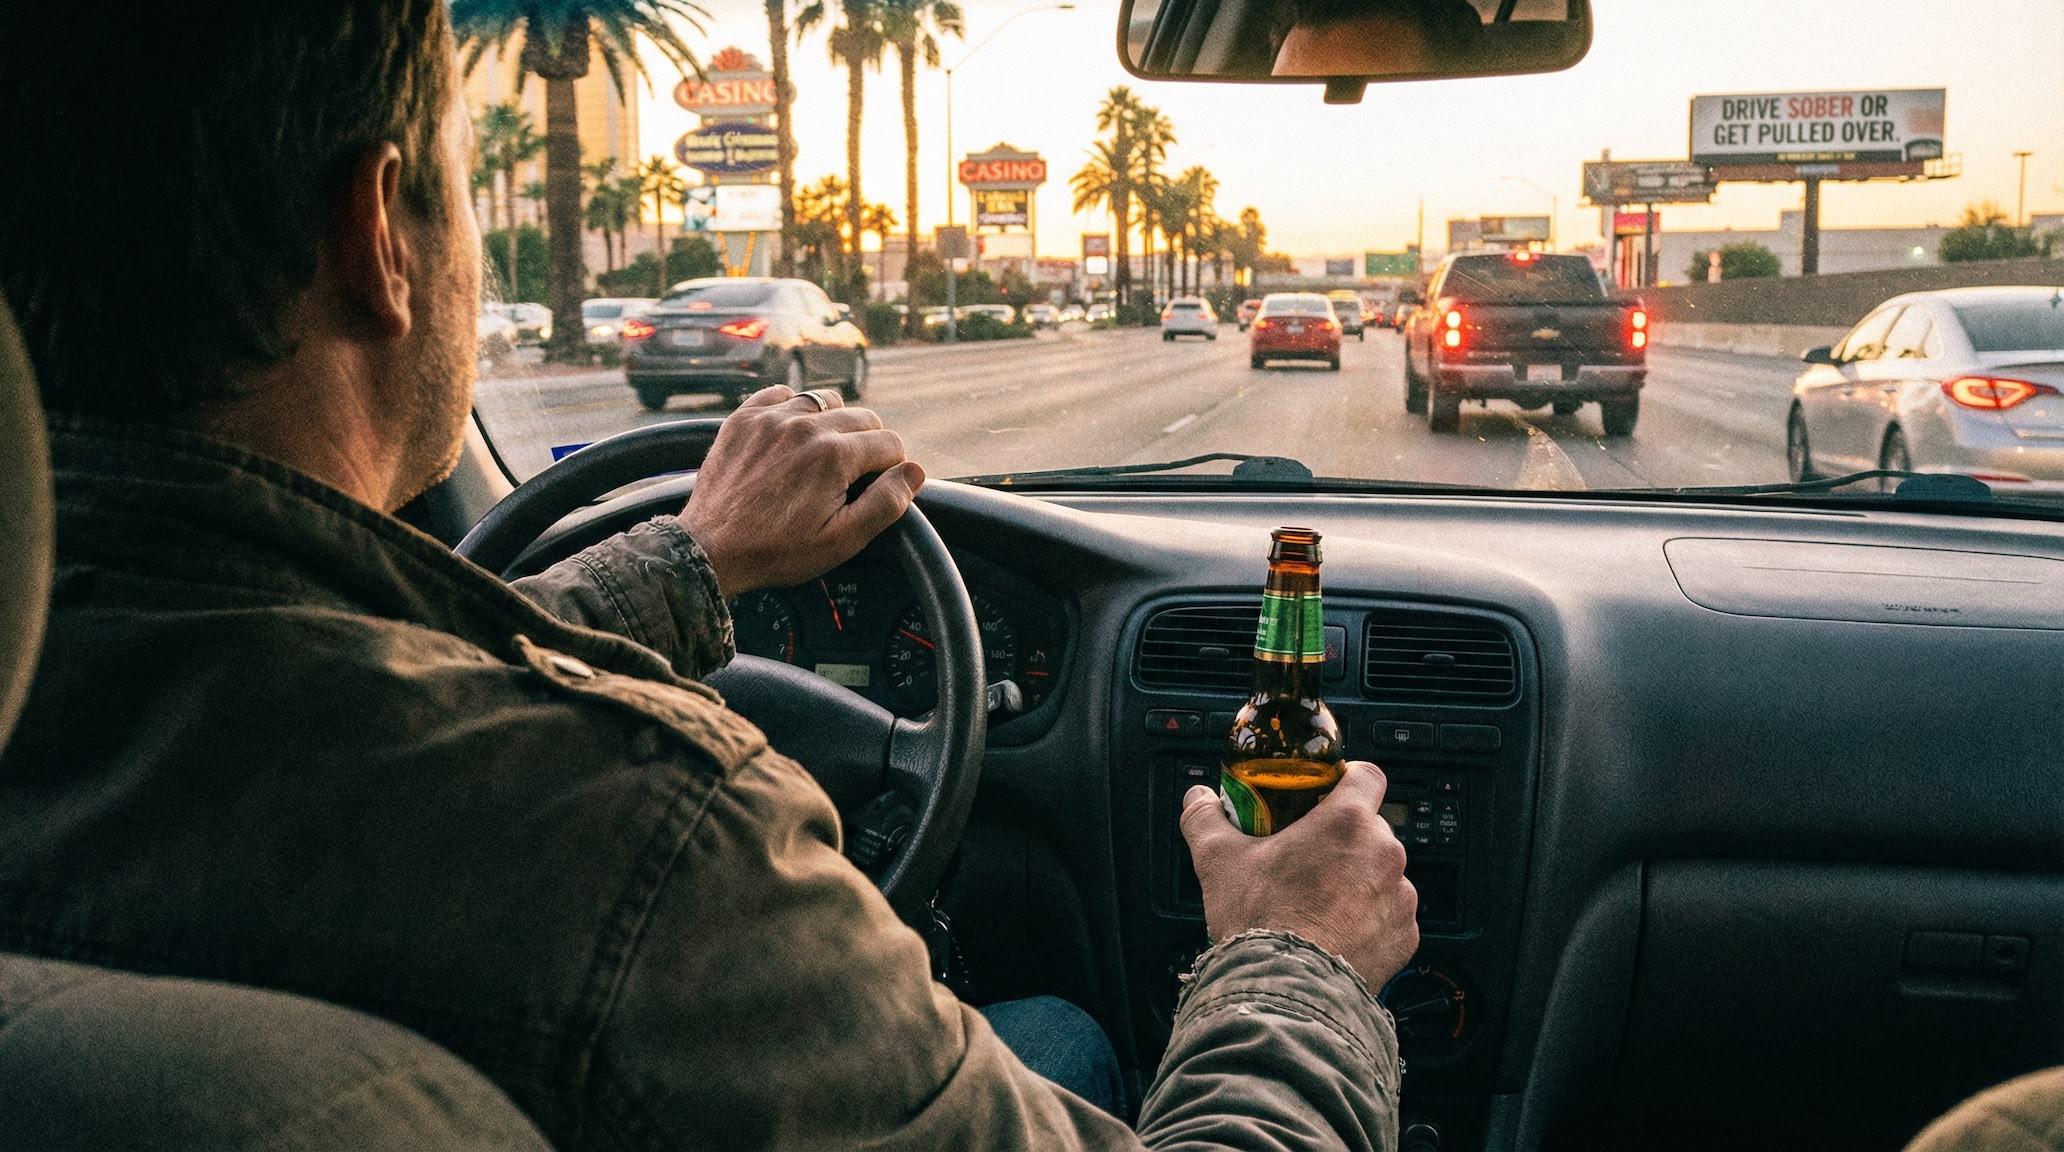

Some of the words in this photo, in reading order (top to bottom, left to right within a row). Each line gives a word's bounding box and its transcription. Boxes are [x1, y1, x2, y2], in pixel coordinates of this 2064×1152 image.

[1722, 98, 1781, 120] DRIVE
[1788, 96, 1854, 119] SOBER
[1861, 95, 1888, 117] OR
[1714, 124, 1752, 145] GET
[1758, 122, 1834, 145] PULLED
[1841, 121, 1901, 143] OVER.
[961, 161, 1045, 180] CASINO
[772, 620, 780, 631] 6
[778, 643, 785, 655] 7
[906, 674, 913, 685] 0
